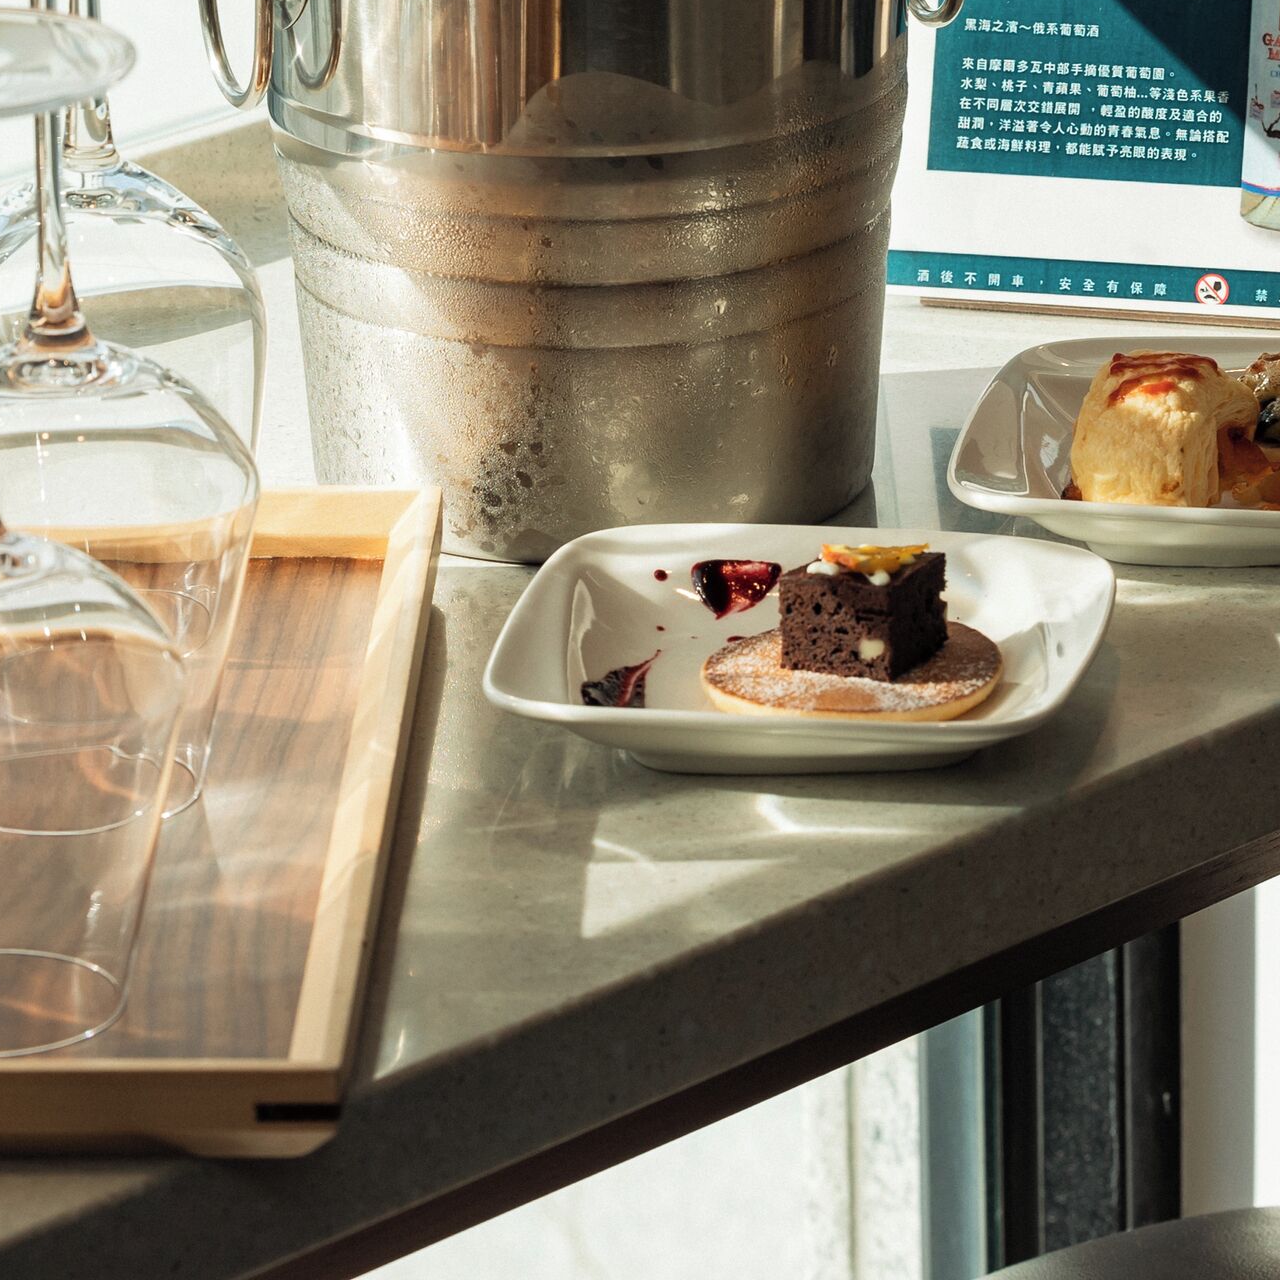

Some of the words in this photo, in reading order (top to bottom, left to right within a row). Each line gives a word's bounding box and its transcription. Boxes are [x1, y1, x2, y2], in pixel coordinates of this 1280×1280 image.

[962, 57, 1175, 81] 來自摩爾多瓦中部手摘優質葡萄園。
